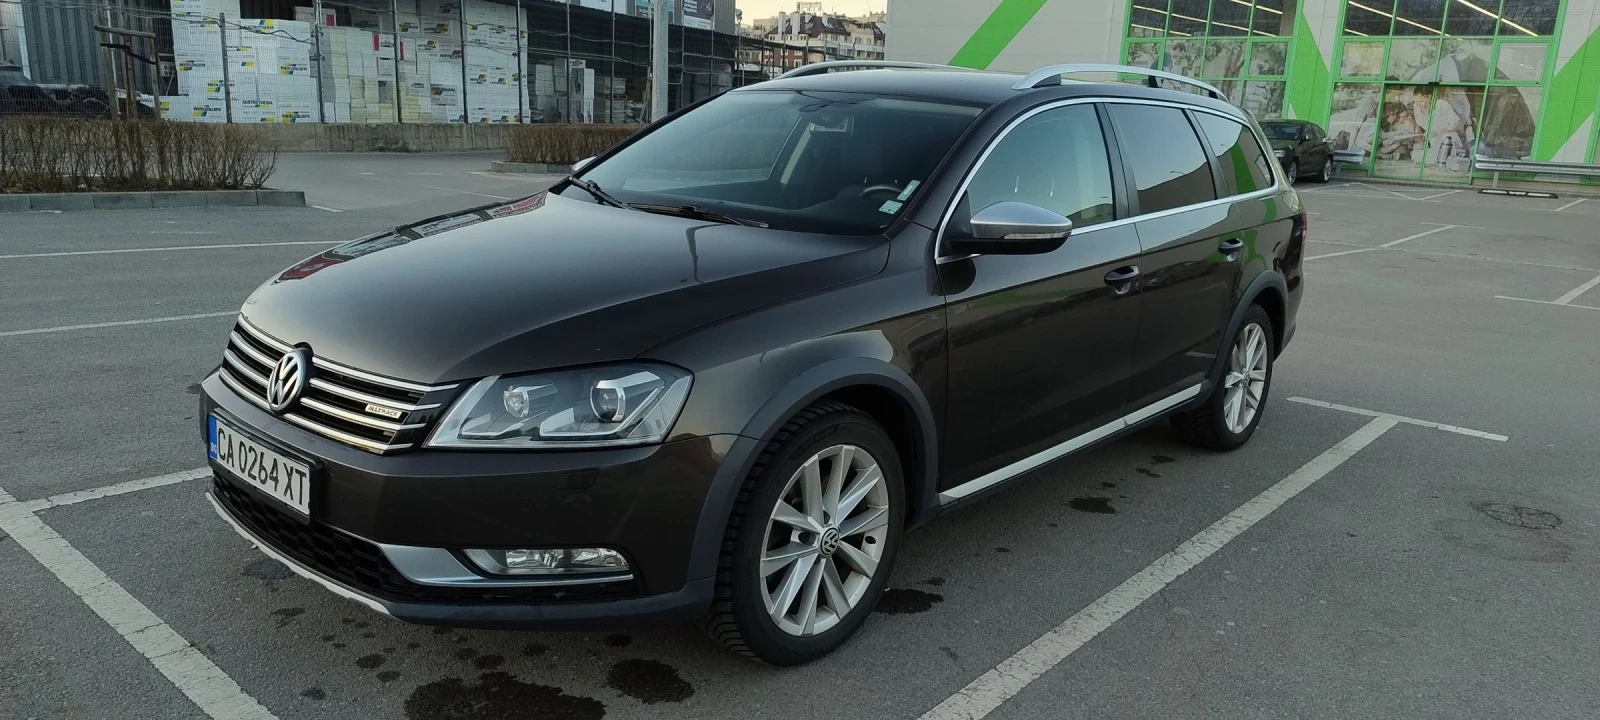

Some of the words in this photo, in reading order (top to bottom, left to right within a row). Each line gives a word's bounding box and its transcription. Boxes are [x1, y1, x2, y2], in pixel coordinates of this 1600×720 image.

[367, 404, 400, 418] ALLTRACK
[218, 427, 234, 468] CA
[239, 440, 279, 492] 0264
[283, 461, 307, 506] XT
